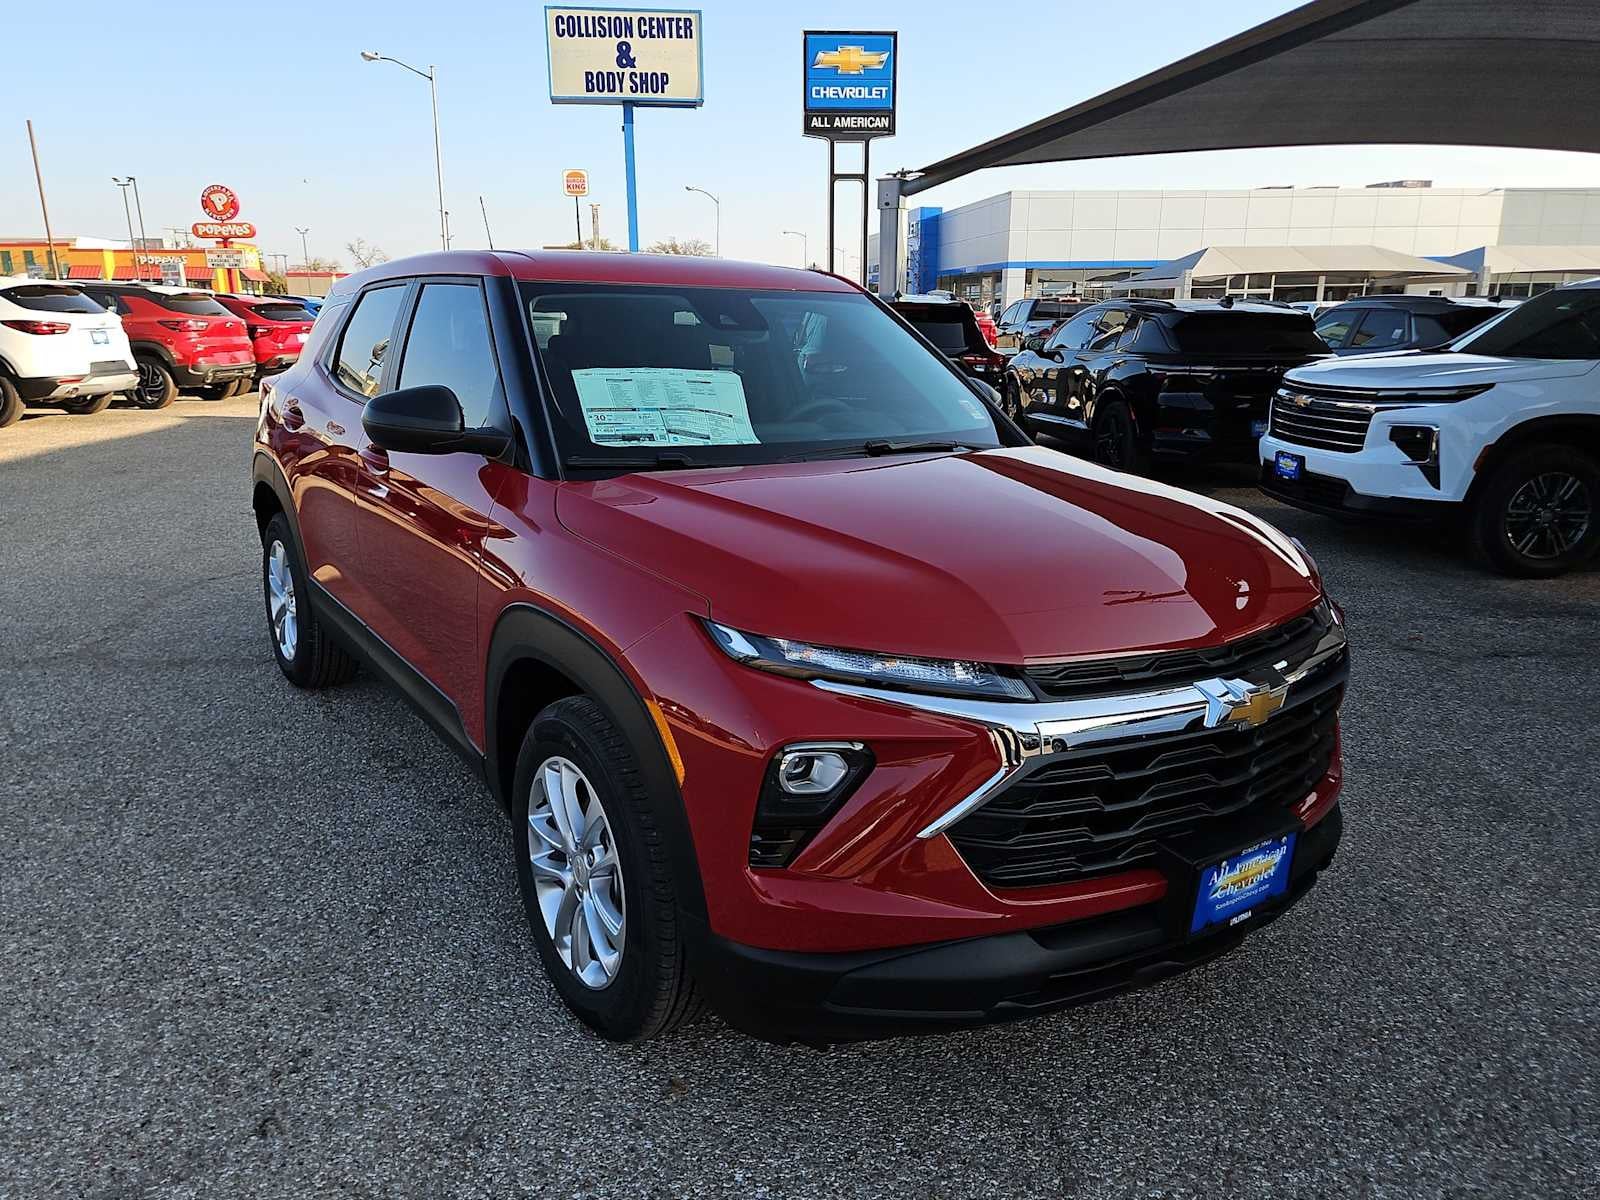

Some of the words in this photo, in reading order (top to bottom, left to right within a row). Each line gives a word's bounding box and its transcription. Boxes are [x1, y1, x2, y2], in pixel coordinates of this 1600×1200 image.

[555, 15, 633, 38] COLLISION
[637, 17, 693, 39] CENTER
[615, 41, 636, 68] &
[585, 71, 625, 93] BODY
[629, 72, 669, 93] SHOP
[811, 86, 889, 99] CHEVROLET
[811, 116, 831, 128] ALL
[833, 117, 889, 128] AMERICAN
[202, 185, 235, 203] LOUISIANA
[204, 207, 235, 220] KITCHEN
[594, 414, 606, 422] 30
[1208, 865, 1229, 886] All
[1233, 845, 1287, 872] American
[1217, 866, 1275, 898] Chevrolet
